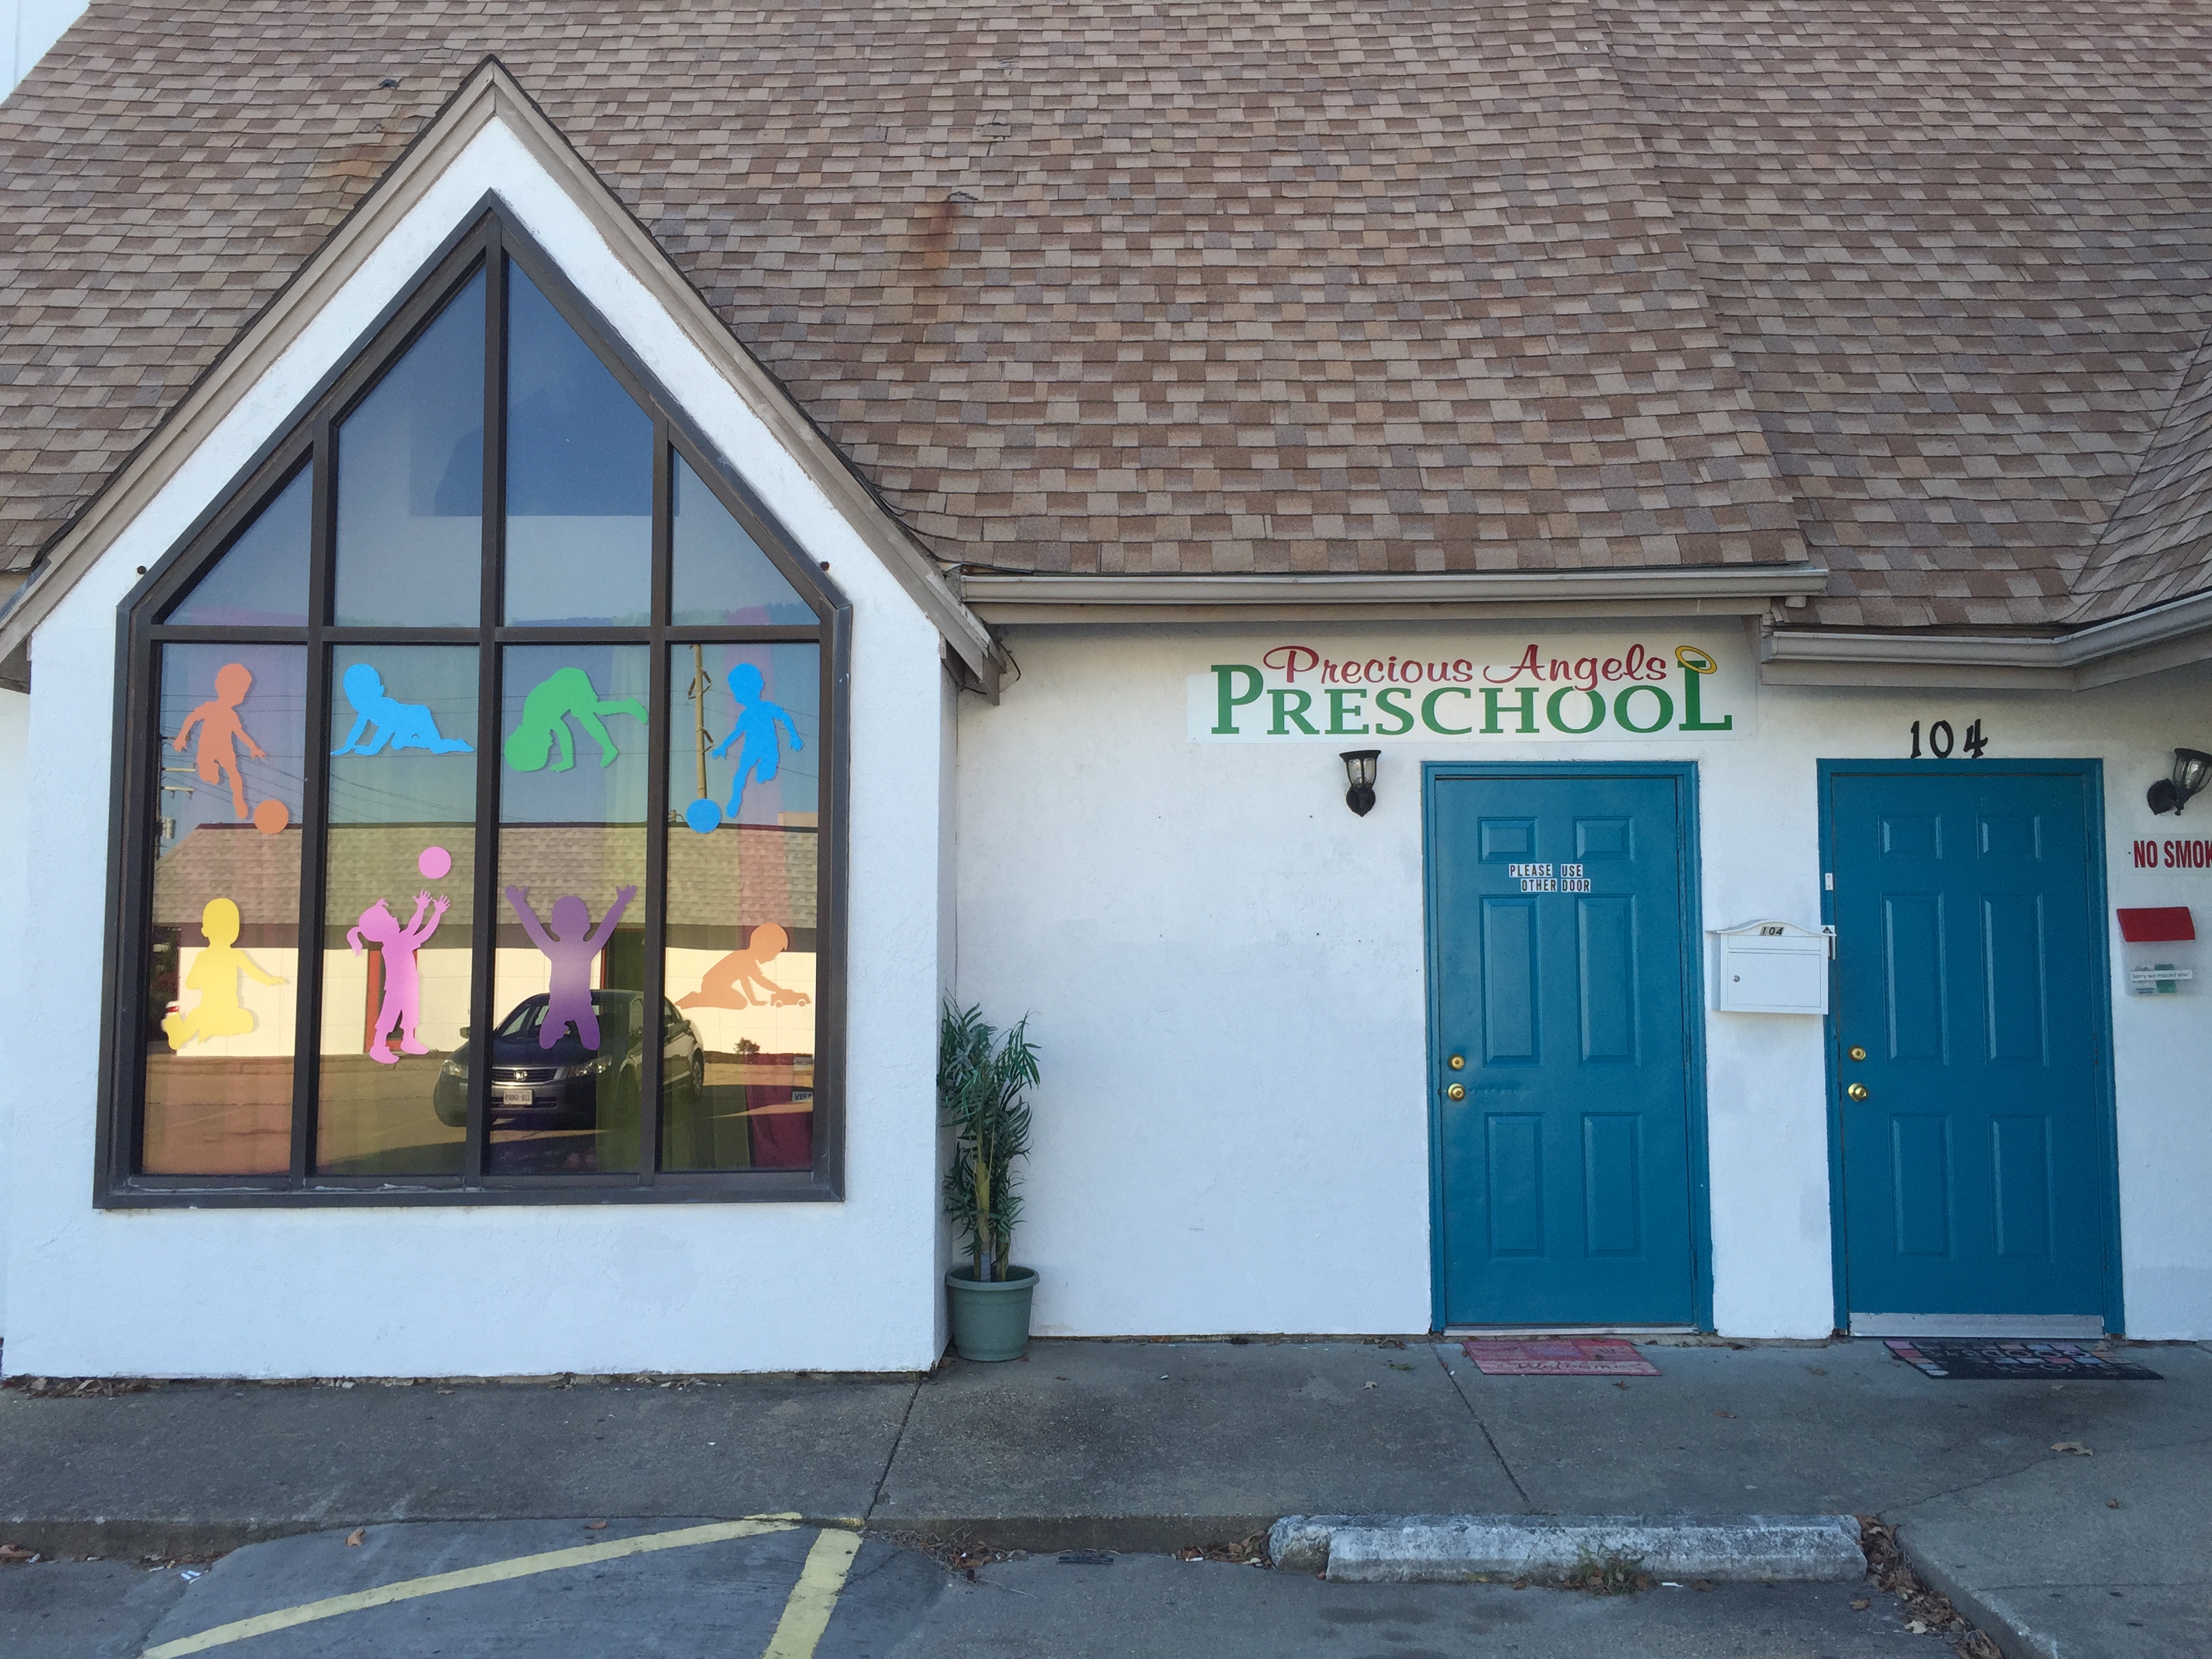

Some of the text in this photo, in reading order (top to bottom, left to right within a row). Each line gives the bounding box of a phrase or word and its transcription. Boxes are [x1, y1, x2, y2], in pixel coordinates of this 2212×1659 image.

[1263, 643, 1667, 692] Precious Angels
[1210, 659, 1733, 736] PRESCHOOL
[1910, 718, 1989, 759] 104
[2133, 840, 2158, 868] NO
[1510, 864, 1582, 877] PLEASE USE
[1521, 879, 1590, 892] OTHER DOOR
[1761, 926, 1784, 936] 104
[794, 1092, 812, 1101] VISA
